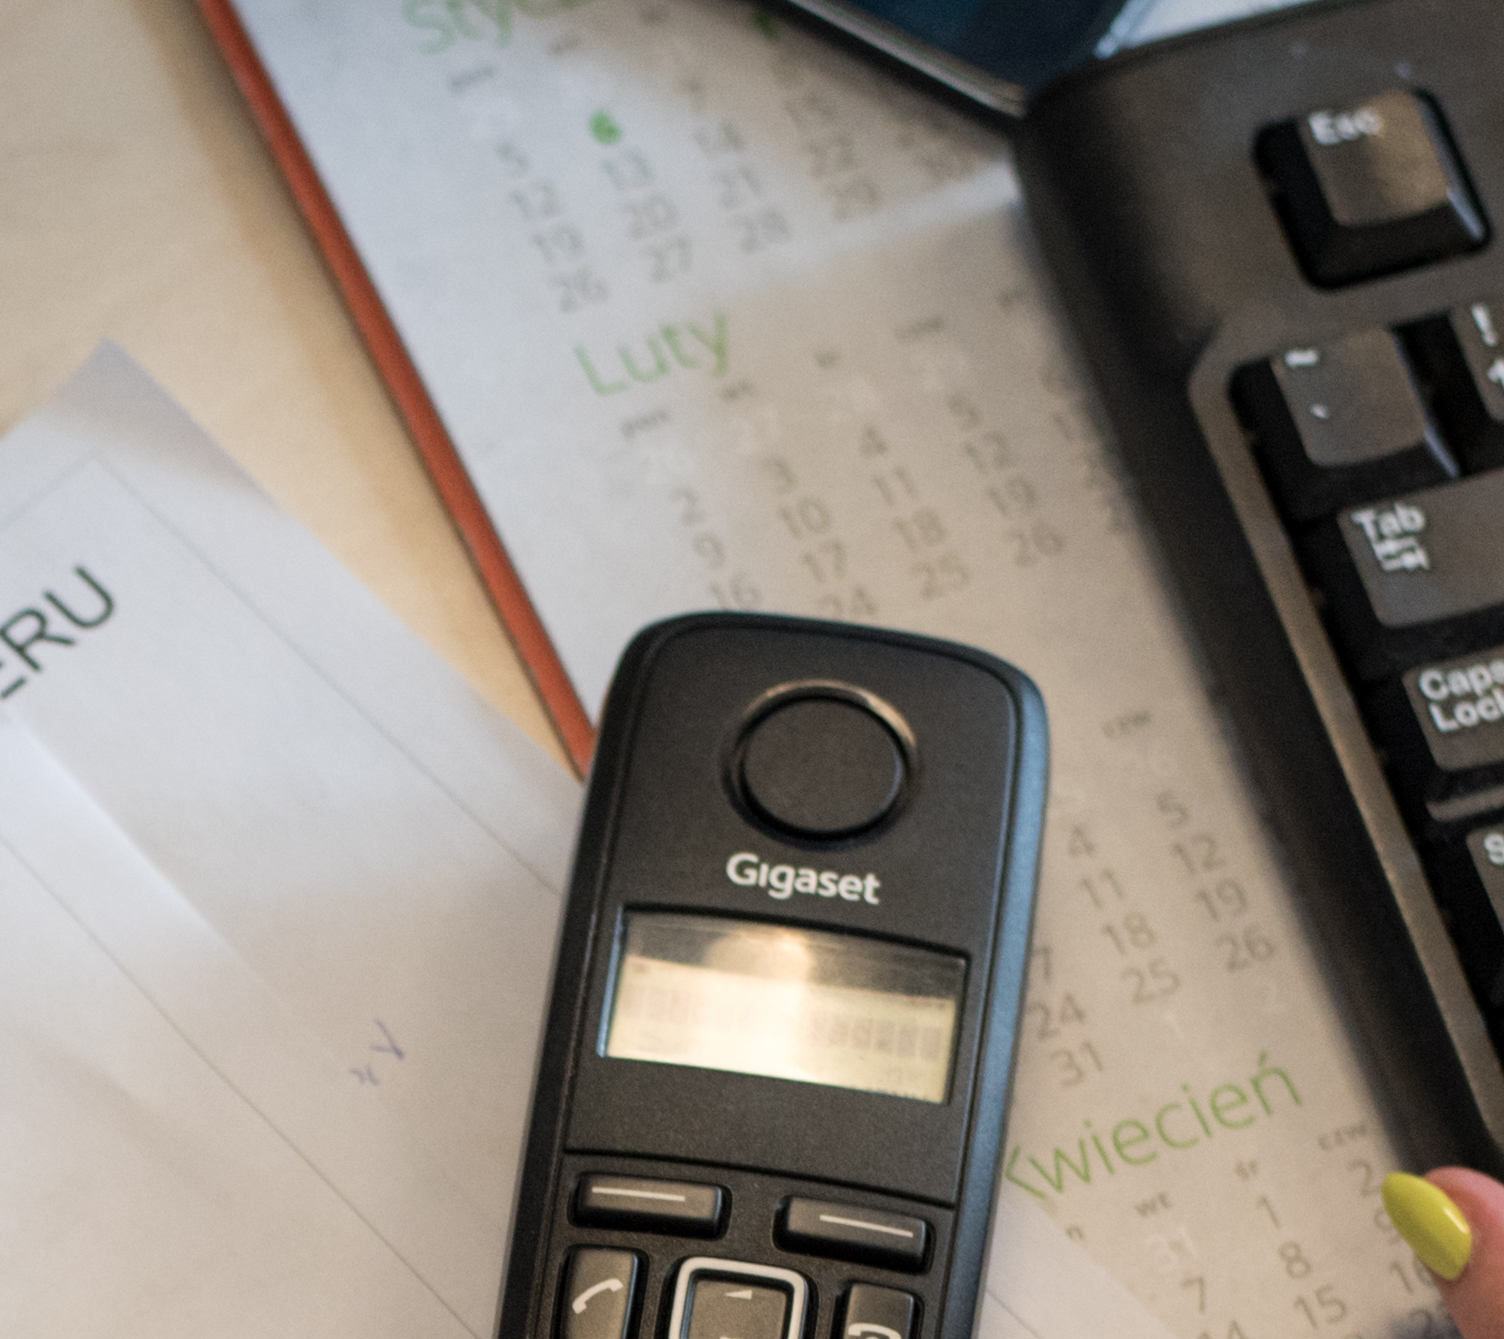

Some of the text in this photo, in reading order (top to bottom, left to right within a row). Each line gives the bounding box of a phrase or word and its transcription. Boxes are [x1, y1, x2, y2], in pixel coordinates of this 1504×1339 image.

[1309, 110, 1382, 145] Esc
[573, 312, 731, 397] Luty
[1352, 503, 1426, 541] Tab
[725, 852, 881, 904] Gigaset
[1195, 878, 1247, 925] 19
[1103, 912, 1157, 955] 18
[1049, 1041, 1105, 1088] 31
[1293, 1286, 1349, 1333] 15
